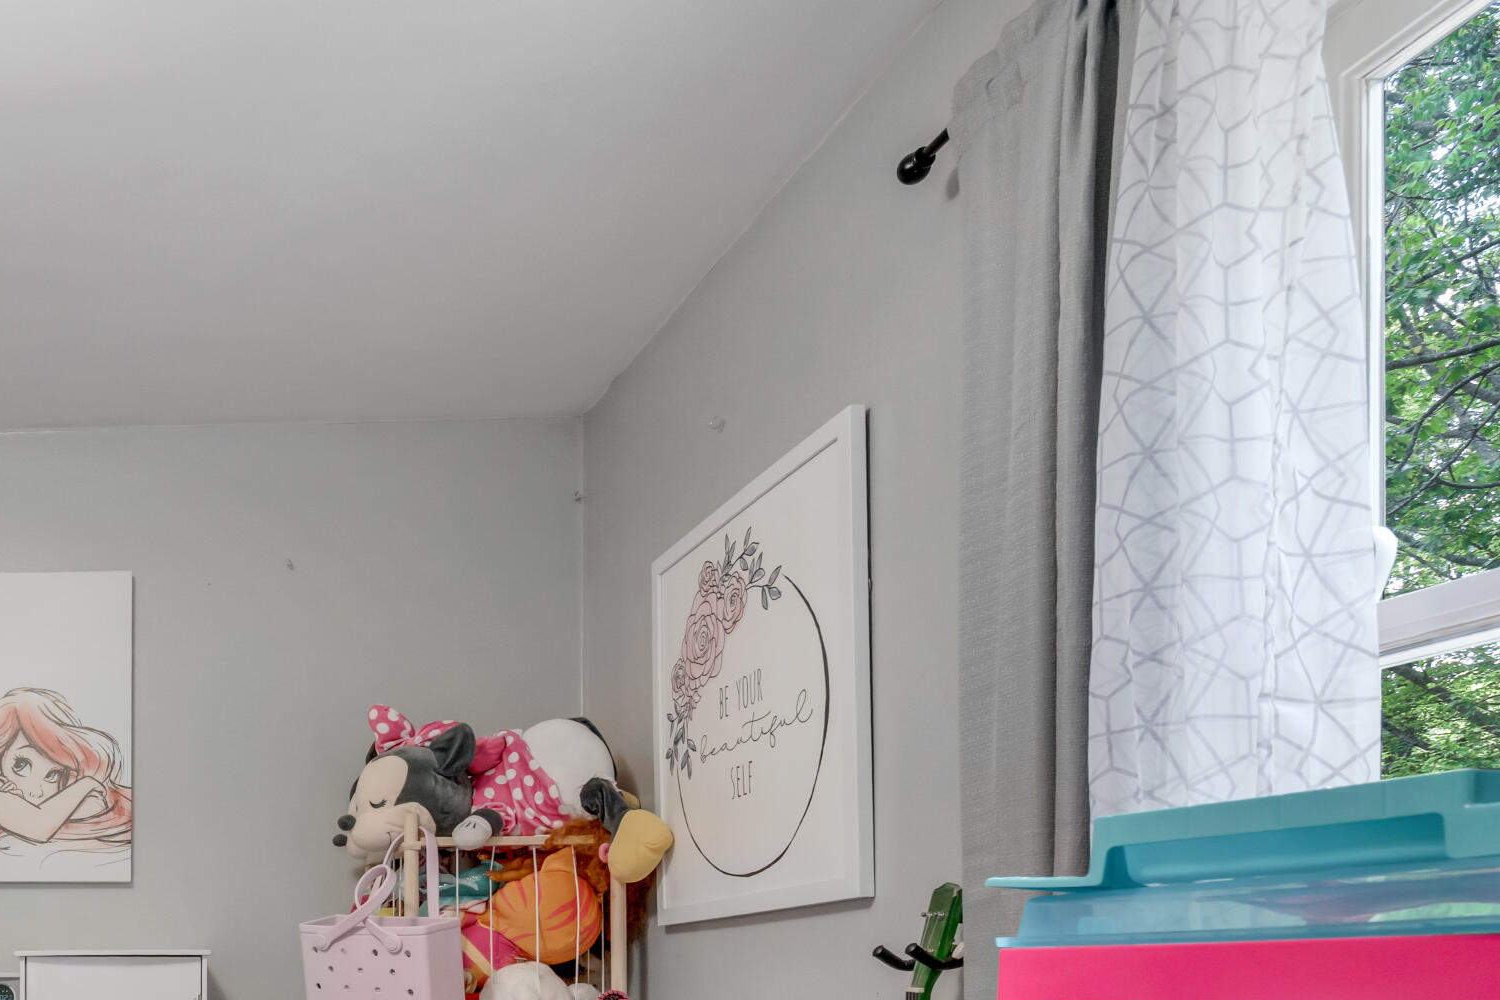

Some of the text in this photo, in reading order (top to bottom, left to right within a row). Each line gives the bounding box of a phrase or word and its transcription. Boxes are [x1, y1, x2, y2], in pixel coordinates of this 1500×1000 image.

[719, 668, 763, 720] BE YOUR
[700, 688, 814, 764] beautiful
[730, 760, 753, 800] SELF
